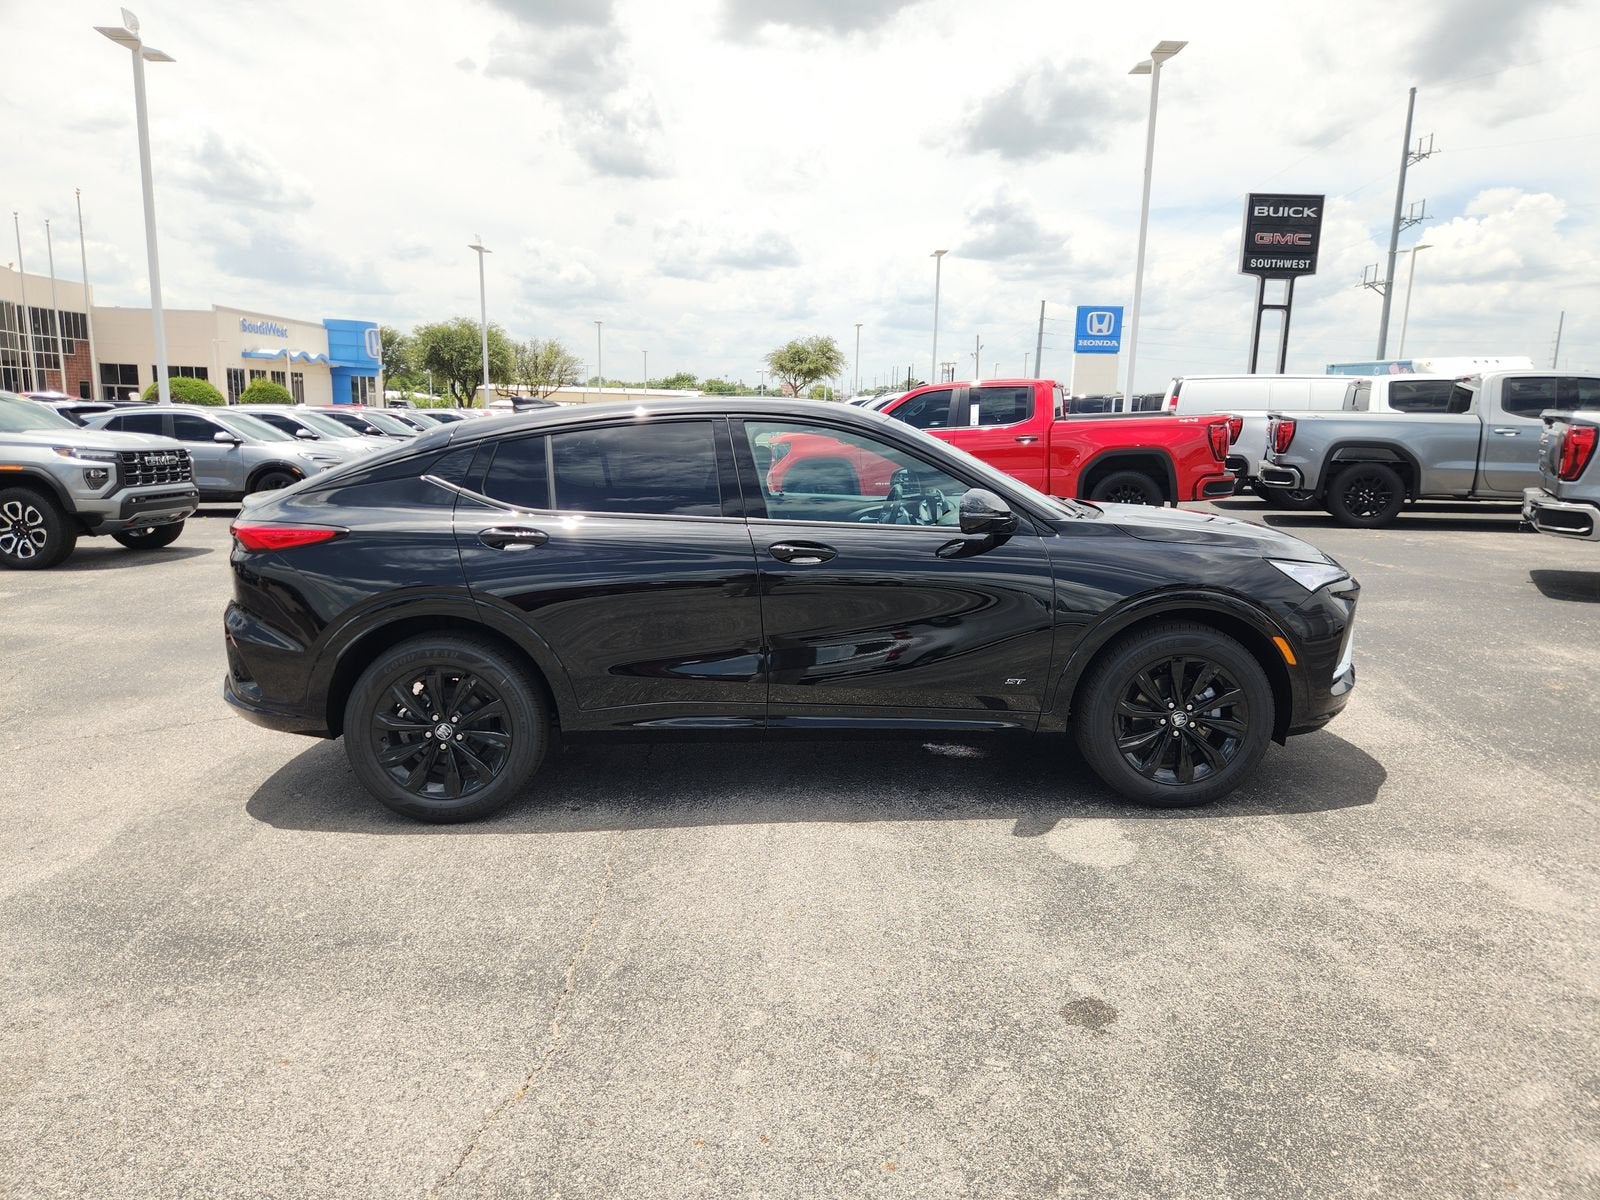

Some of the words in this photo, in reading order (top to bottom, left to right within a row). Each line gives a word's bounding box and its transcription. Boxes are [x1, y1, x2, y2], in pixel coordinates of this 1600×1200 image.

[1253, 206, 1318, 218] BUICK
[1254, 232, 1312, 246] GMC
[1250, 258, 1311, 269] SOUTHWEST
[1077, 339, 1119, 347] HONDA
[144, 455, 178, 466] GMC
